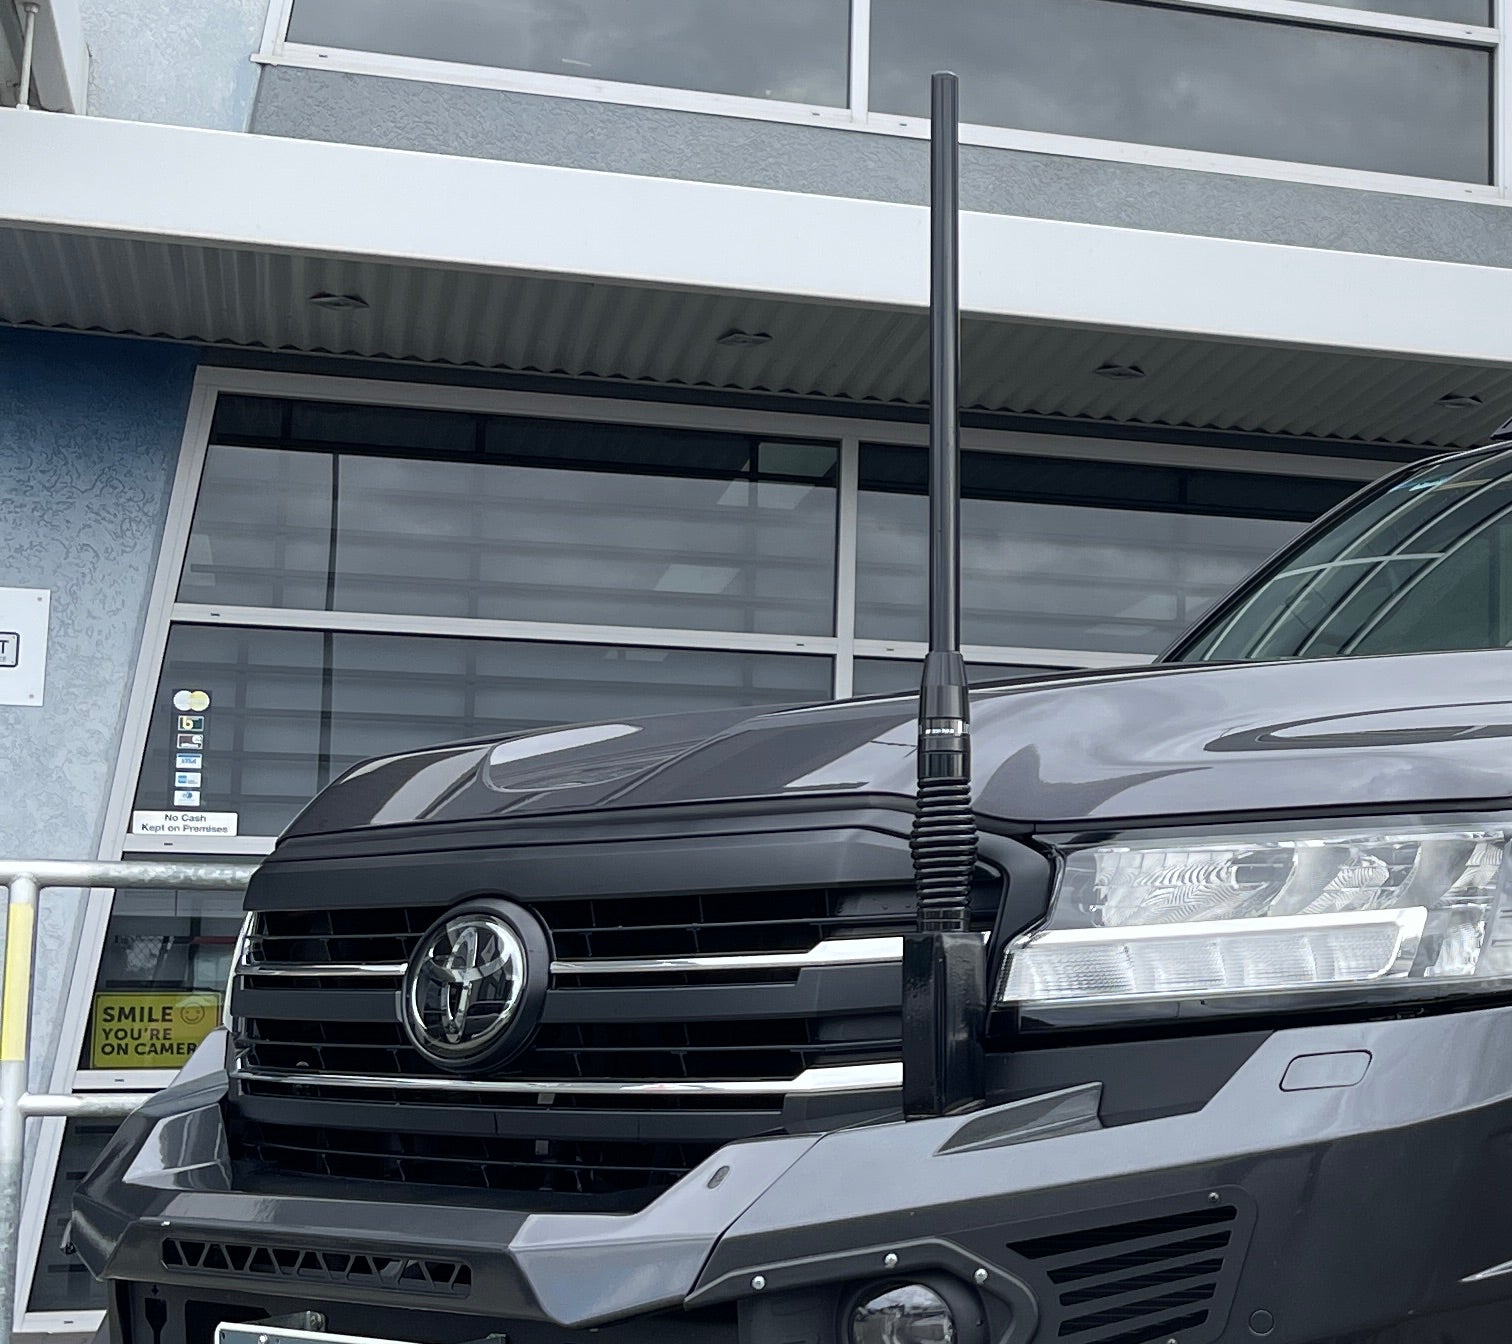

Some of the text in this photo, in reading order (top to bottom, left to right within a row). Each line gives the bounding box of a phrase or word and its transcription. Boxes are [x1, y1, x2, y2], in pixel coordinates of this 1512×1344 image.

[164, 814, 207, 822] No Cash
[141, 823, 165, 833] Kept
[182, 823, 228, 833] Premises
[102, 1006, 173, 1023] SMILE
[102, 1027, 172, 1041] YOU'RE
[101, 1042, 198, 1055] ON CAMER
